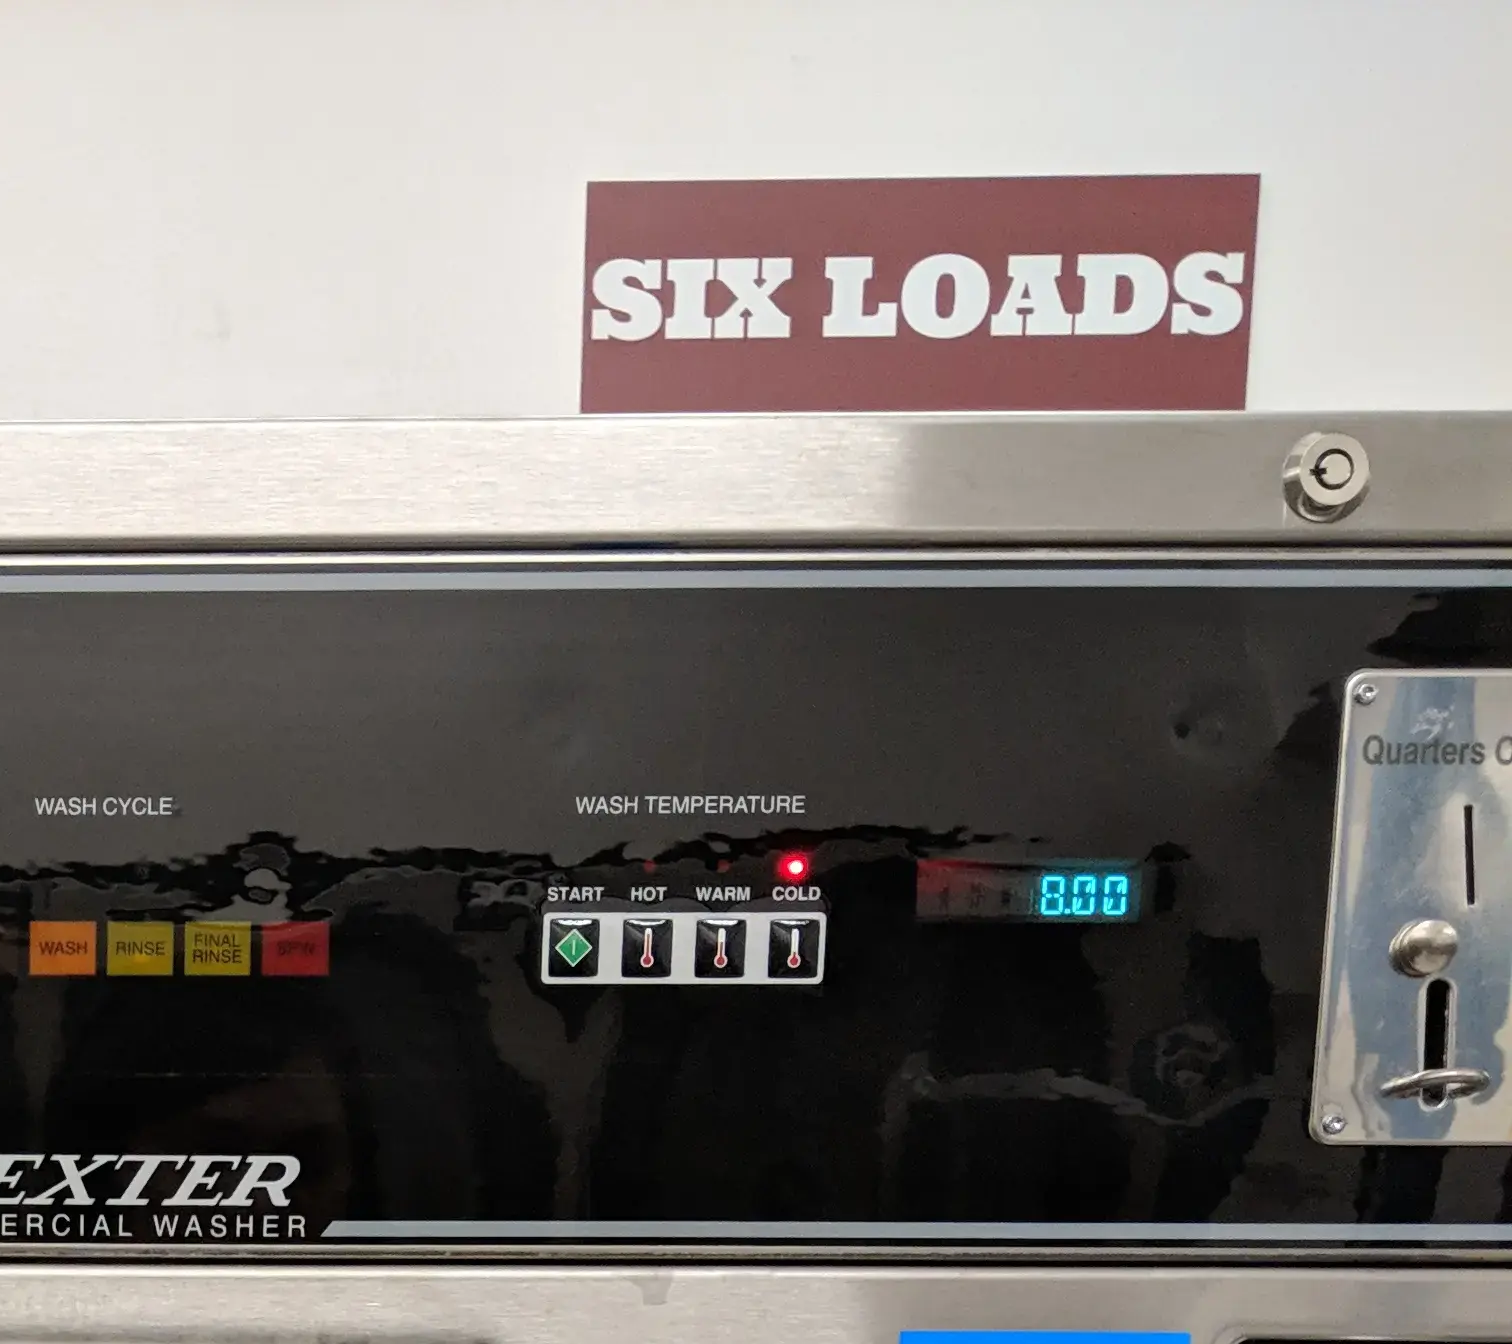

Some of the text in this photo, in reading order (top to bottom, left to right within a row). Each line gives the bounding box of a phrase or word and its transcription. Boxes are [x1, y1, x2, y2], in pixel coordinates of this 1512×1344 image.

[591, 252, 1245, 341] SIX LOADS
[1362, 736, 1486, 766] Quarters
[35, 797, 173, 815] WASH CYCLE
[576, 796, 806, 814] WASH TEMPERATURE
[548, 887, 821, 901] START HOT WARM COLD
[39, 942, 88, 955] WASH
[116, 942, 165, 956] RINSE
[194, 934, 240, 948] FINAL
[193, 949, 242, 963] RINSE
[153, 1216, 306, 1237] WASHER
